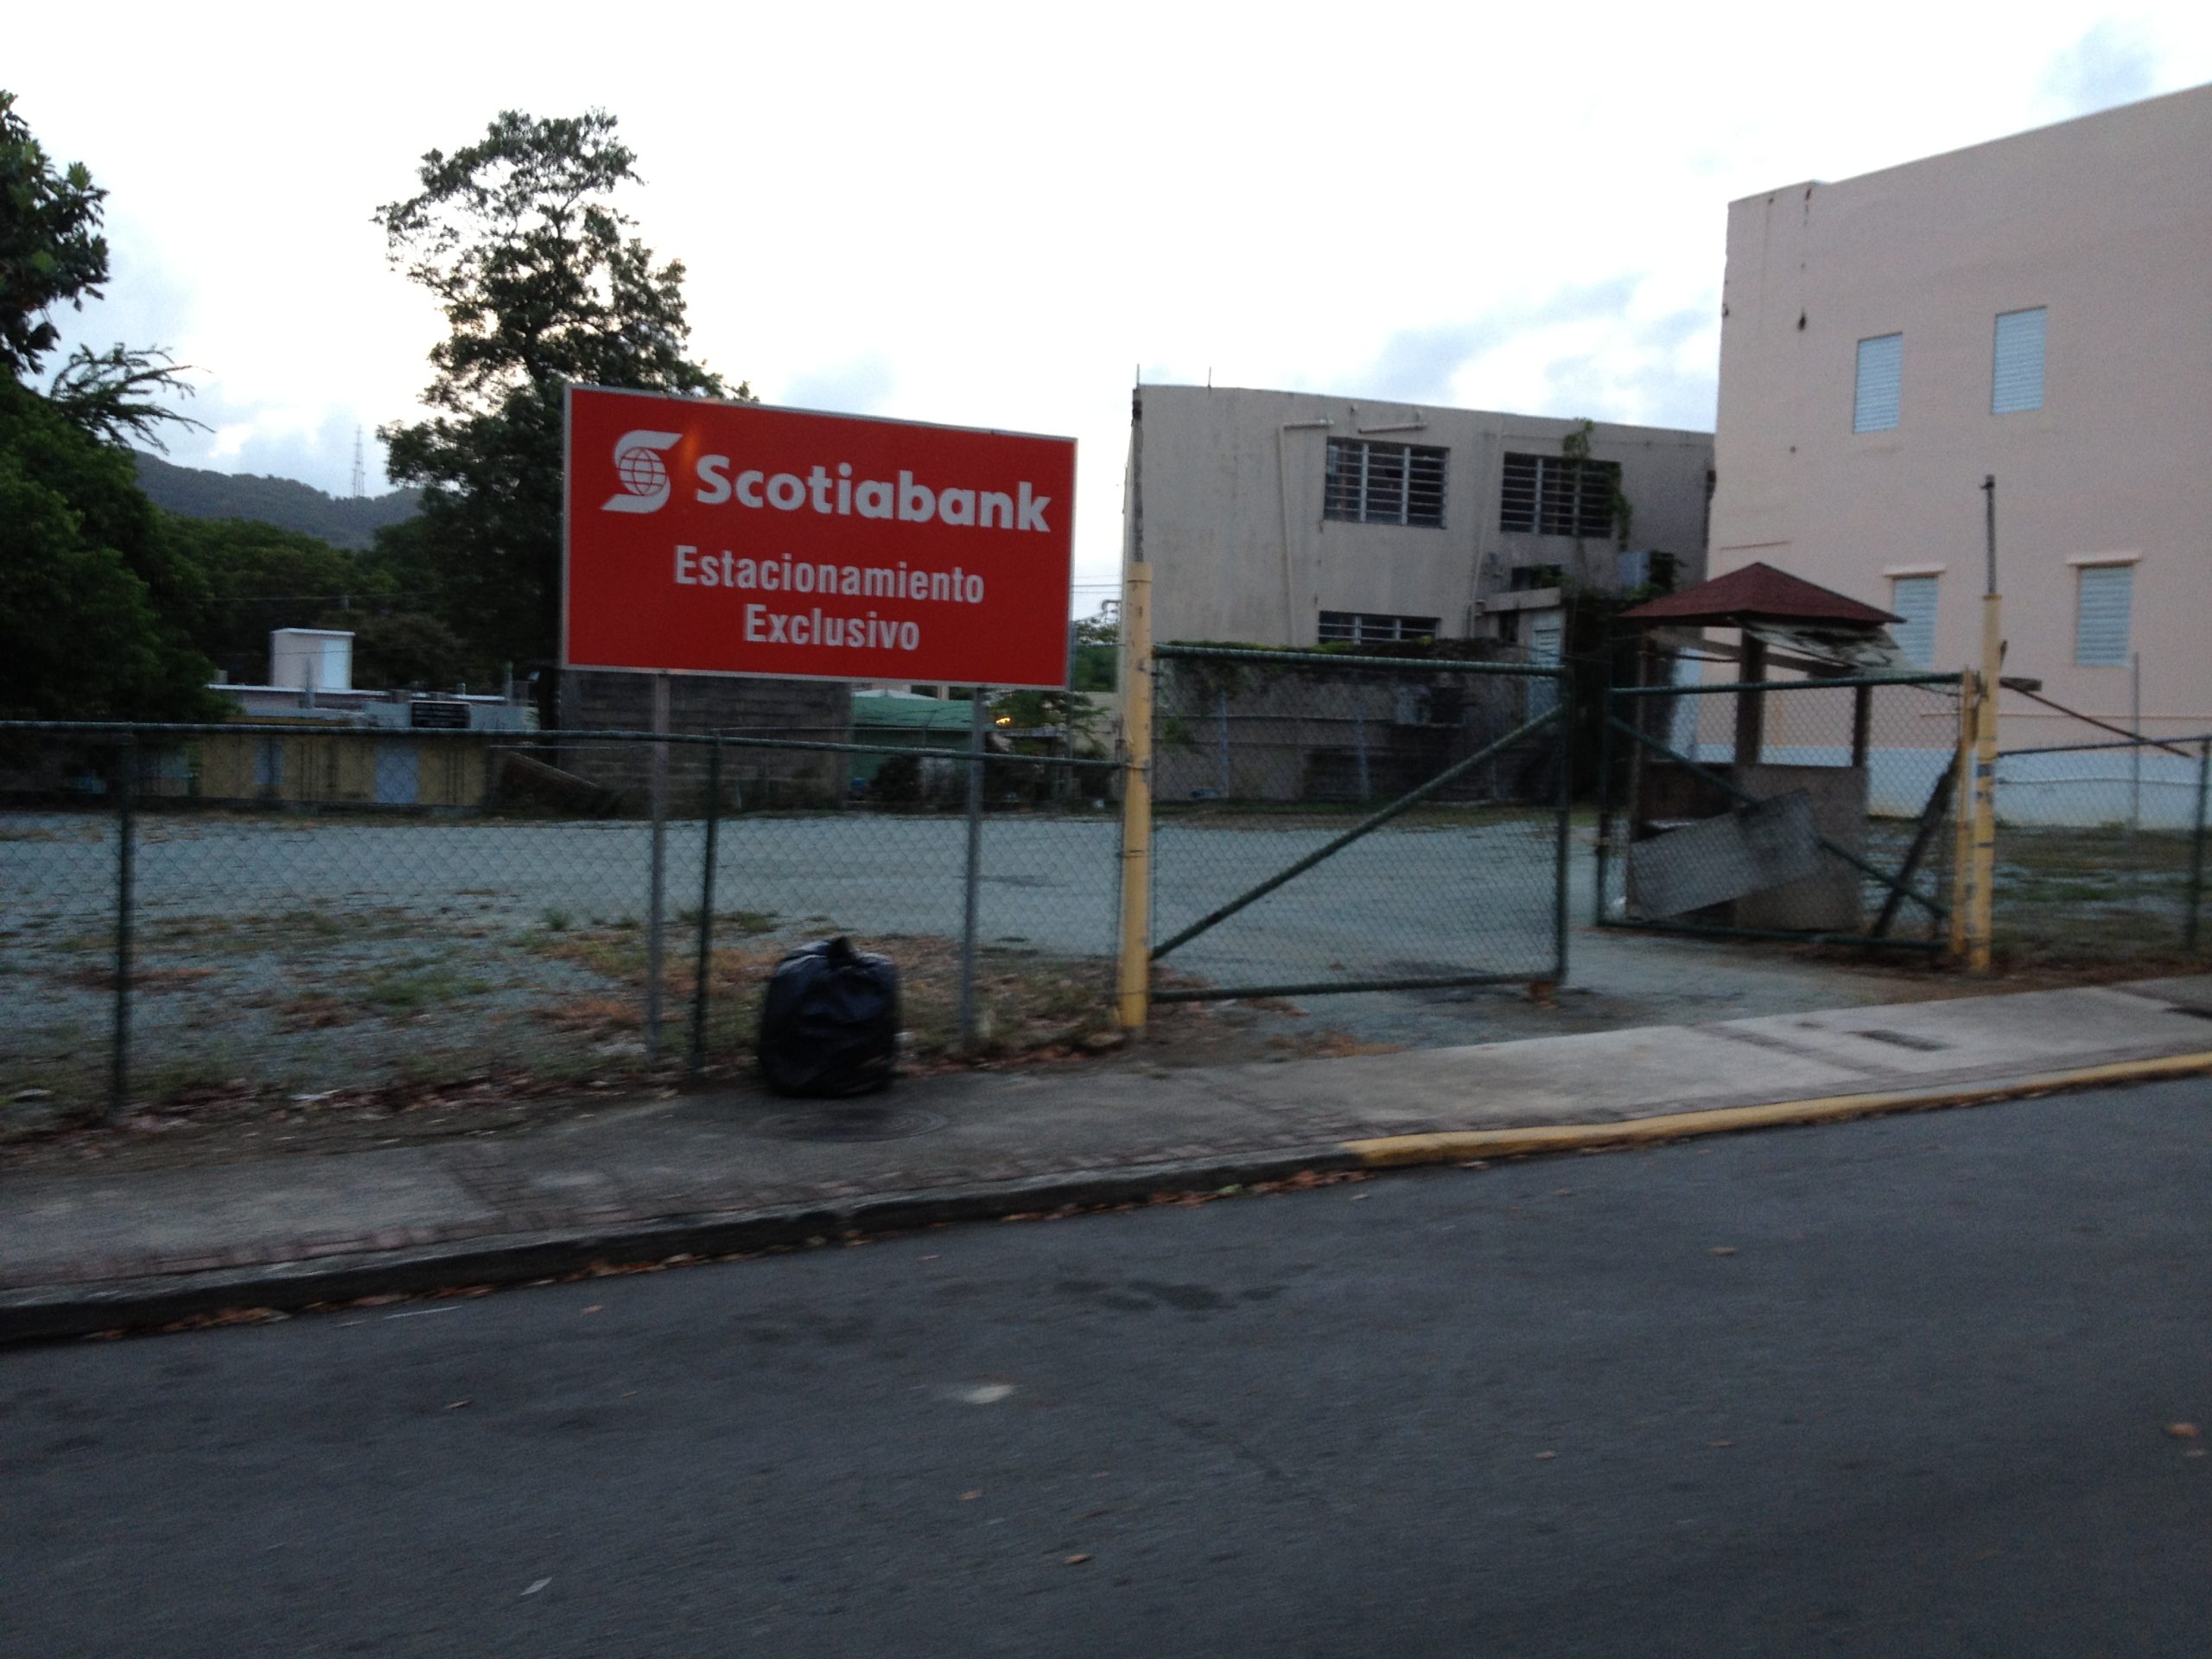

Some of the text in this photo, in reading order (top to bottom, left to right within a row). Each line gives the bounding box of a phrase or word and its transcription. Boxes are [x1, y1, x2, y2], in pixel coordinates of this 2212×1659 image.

[695, 454, 1052, 532] Scotiabank
[675, 545, 985, 603] Estacionamiento
[745, 604, 920, 651] Exclusivo
